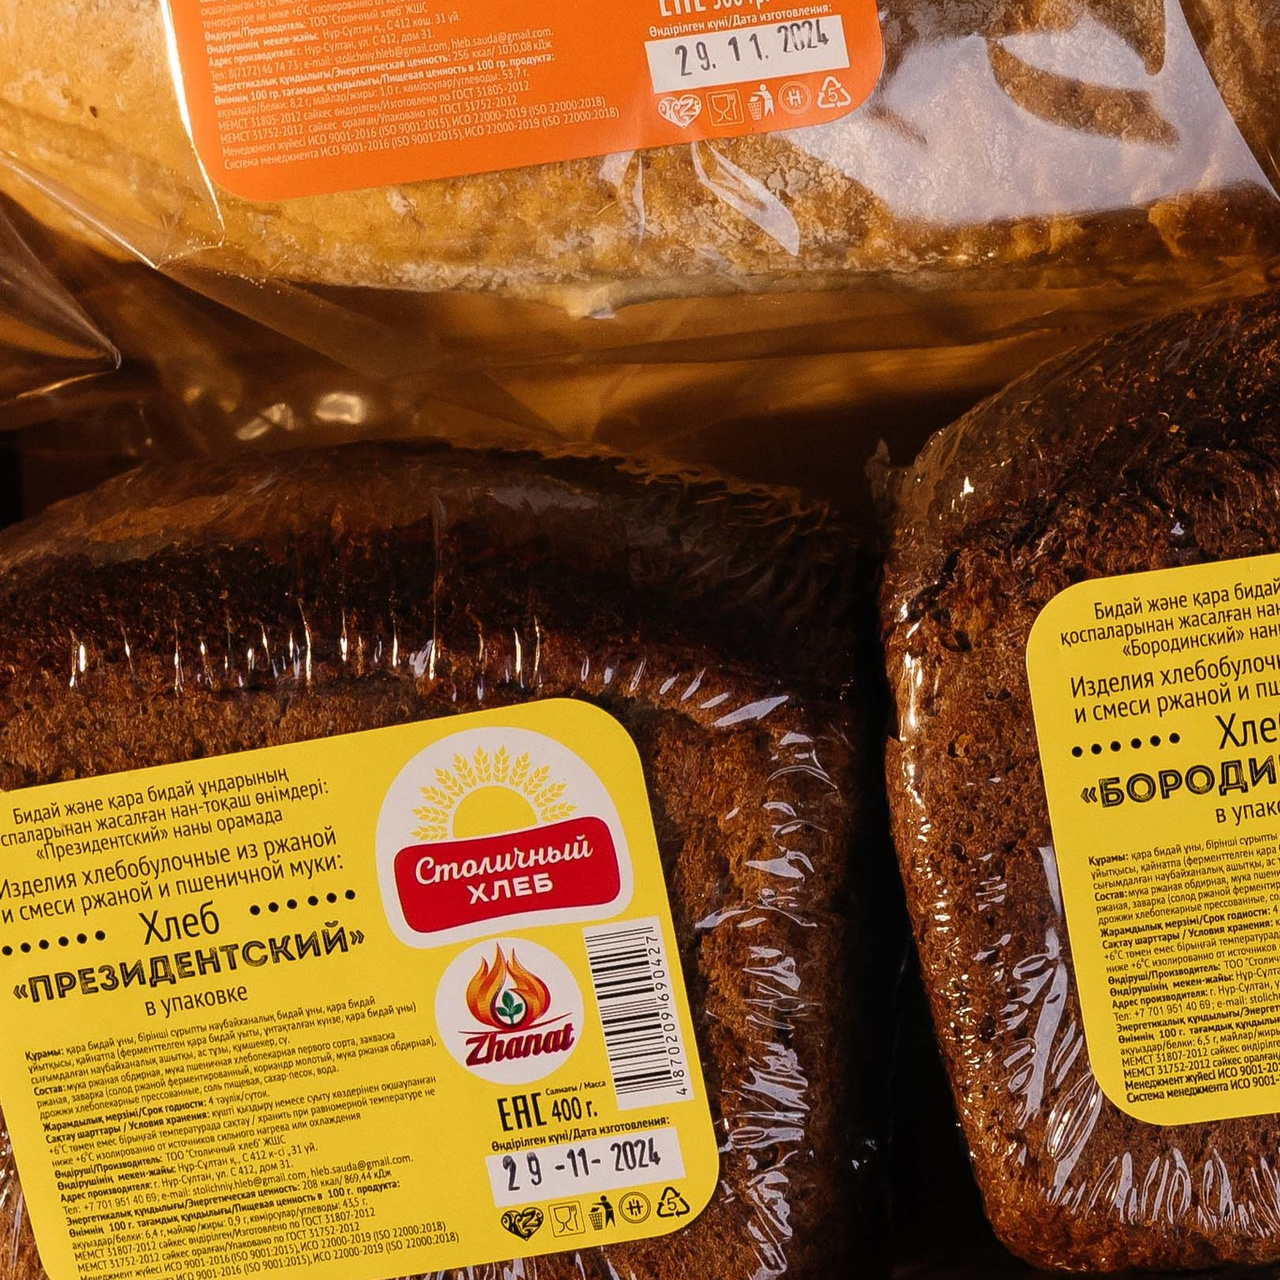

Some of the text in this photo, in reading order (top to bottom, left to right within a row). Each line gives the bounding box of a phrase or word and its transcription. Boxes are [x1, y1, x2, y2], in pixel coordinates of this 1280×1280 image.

[1092, 595, 1144, 621] Бидай
[1145, 593, 1189, 614] және
[1191, 587, 1231, 609] қара
[1059, 616, 1175, 648] қоспаларынан
[1176, 605, 1253, 630] жасалған
[1121, 624, 1245, 659] «Бородинский»
[1069, 670, 1155, 700] Изделия
[1073, 705, 1088, 725] и
[1091, 696, 1152, 722] смеси
[1155, 680, 1233, 719] ржаной
[1236, 683, 1251, 702] и
[1214, 806, 1228, 825] в
[0, 824, 337, 901] Изделия хлебобулочные из ржаной
[414, 833, 594, 885] Столичный
[465, 871, 553, 905] ХЛЕБ
[136, 898, 221, 947] Хлеб
[11, 918, 366, 1004] «ПРЕЗИДЕНТСКИЙ»
[143, 984, 249, 1020] в упаковке
[464, 1021, 575, 1067] Zhanat
[550, 1095, 599, 1124] 400 г.
[608, 1135, 662, 1173] 2024
